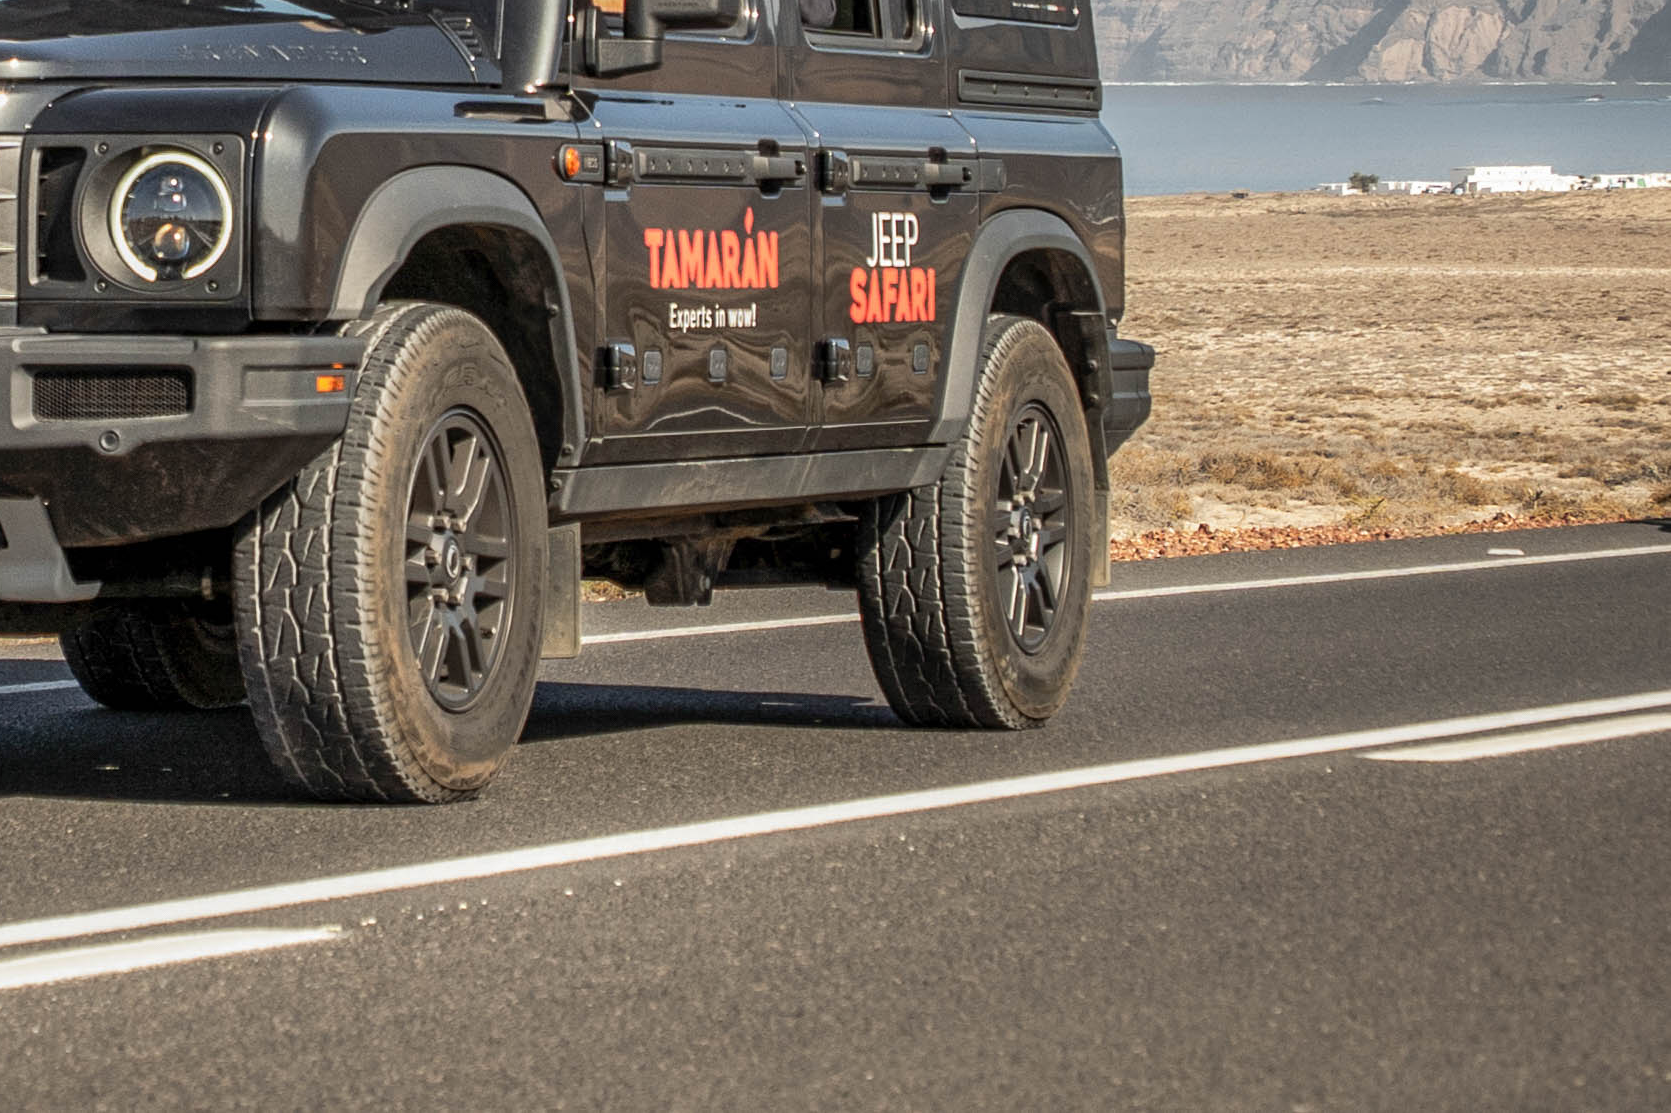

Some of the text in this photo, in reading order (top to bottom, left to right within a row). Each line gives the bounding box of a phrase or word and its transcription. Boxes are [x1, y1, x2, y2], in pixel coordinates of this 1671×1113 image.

[644, 206, 779, 289] TAMARÁN
[866, 212, 919, 267] JEEP
[669, 302, 757, 333] Experts in wow!
[850, 267, 936, 324] SAFARI
